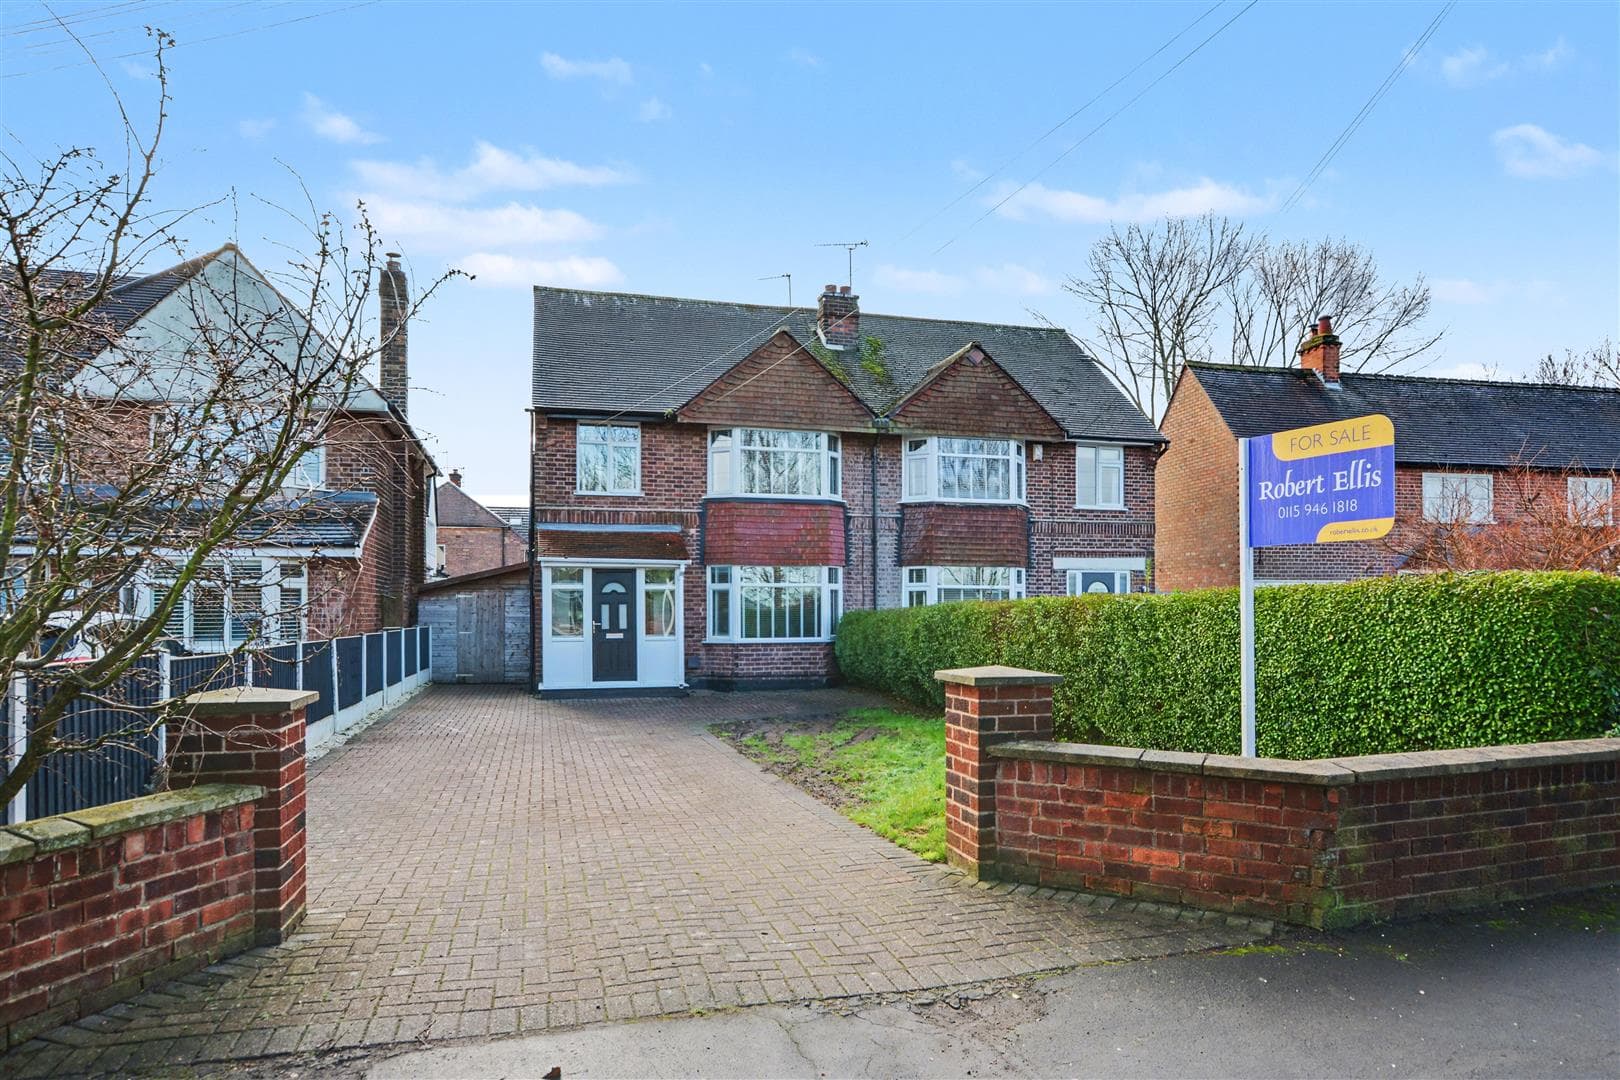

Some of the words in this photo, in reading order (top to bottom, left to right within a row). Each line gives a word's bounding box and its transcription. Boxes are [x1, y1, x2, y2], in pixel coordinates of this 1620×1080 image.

[1290, 433, 1323, 452] FOR
[1330, 424, 1371, 445] SALE
[1258, 469, 1325, 500] Robert
[1333, 459, 1382, 491] Ellis
[1278, 505, 1300, 518] 0115
[1304, 503, 1328, 516] 946
[1332, 499, 1358, 513] 1818
